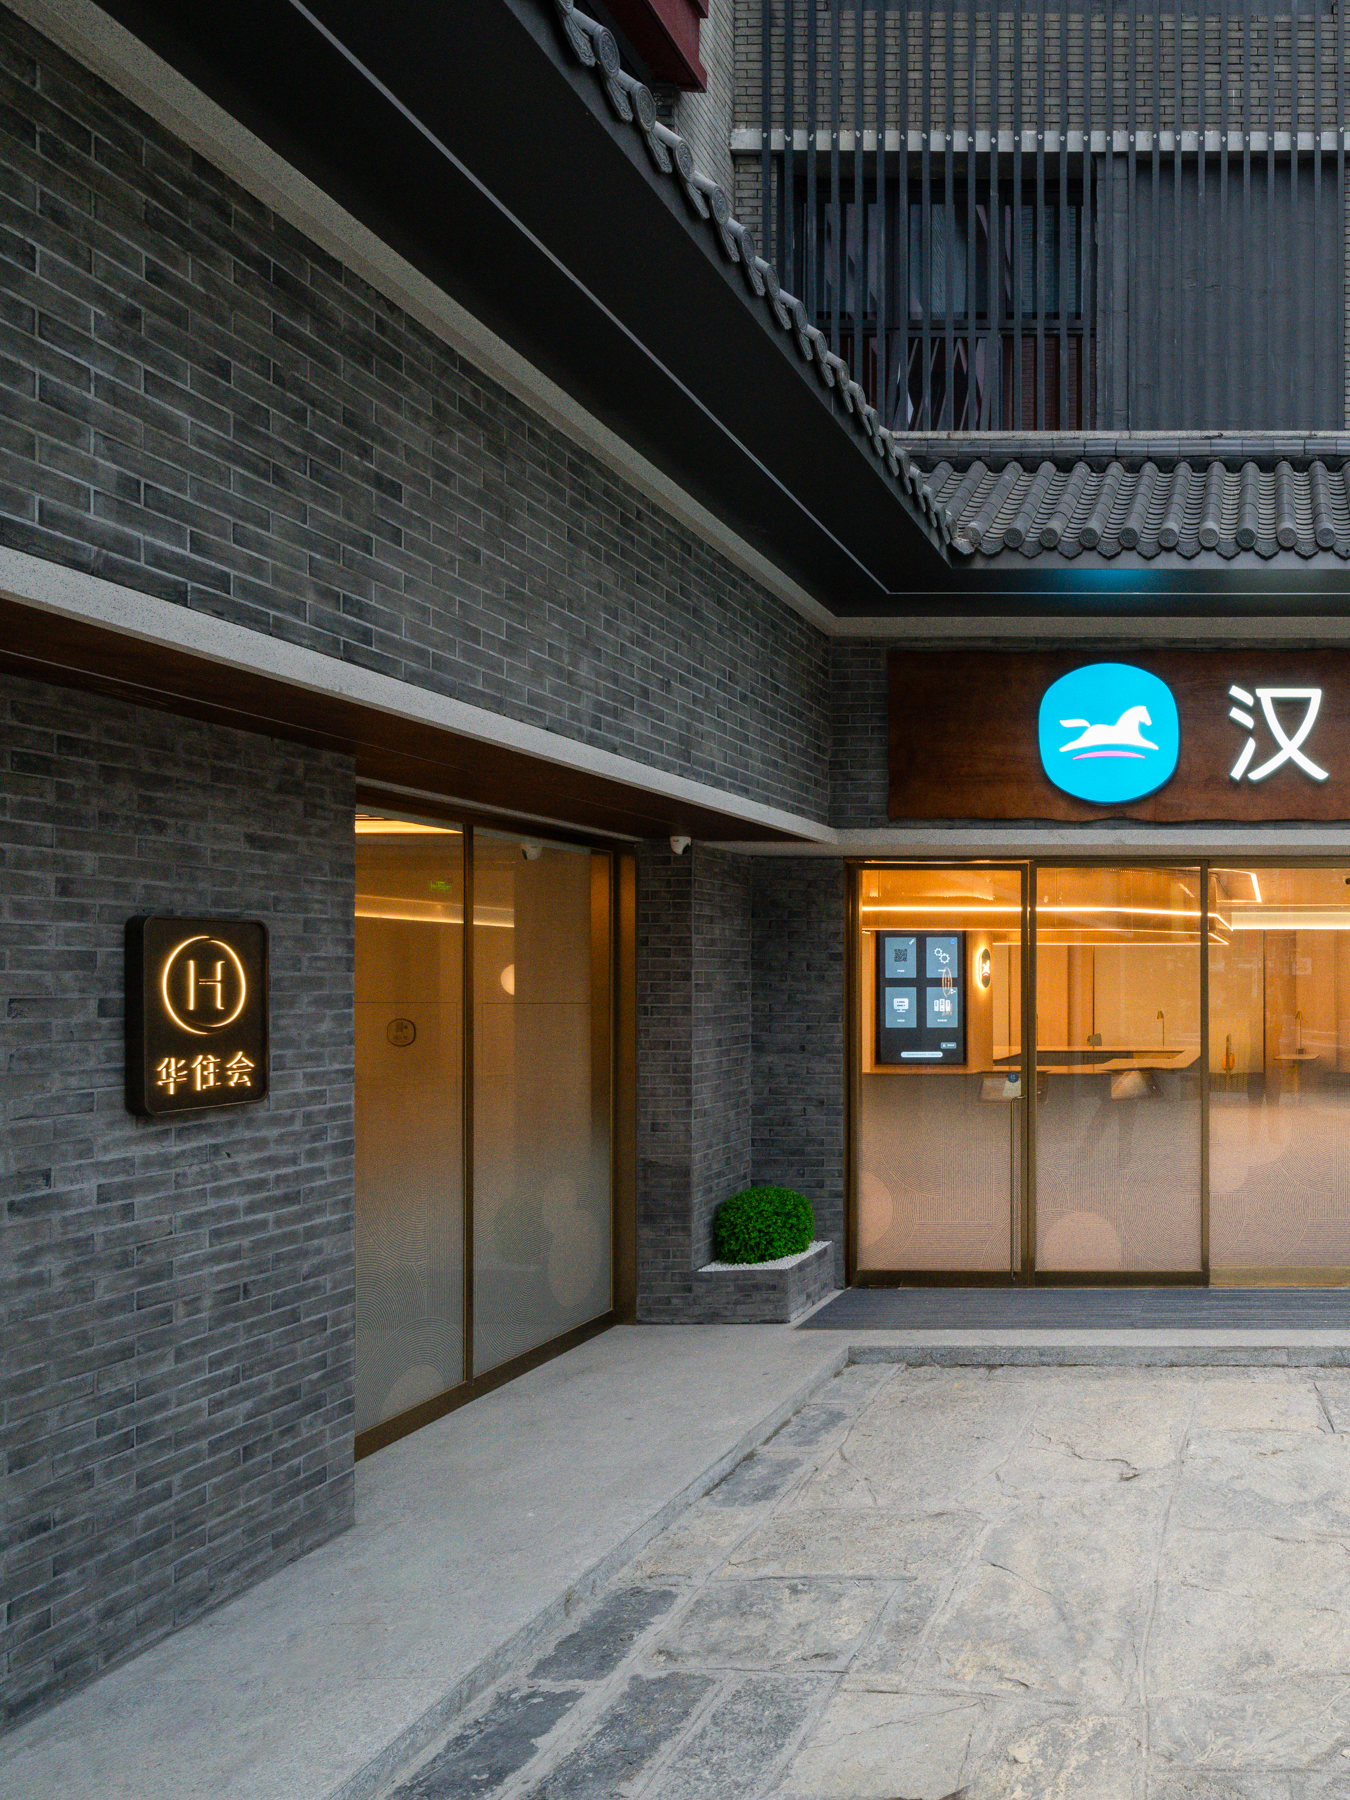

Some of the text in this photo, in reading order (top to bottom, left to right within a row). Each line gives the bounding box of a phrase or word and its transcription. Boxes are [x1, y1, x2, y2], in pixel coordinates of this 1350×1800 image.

[187, 959, 226, 1011] H
[156, 1050, 255, 1095] 华住会
